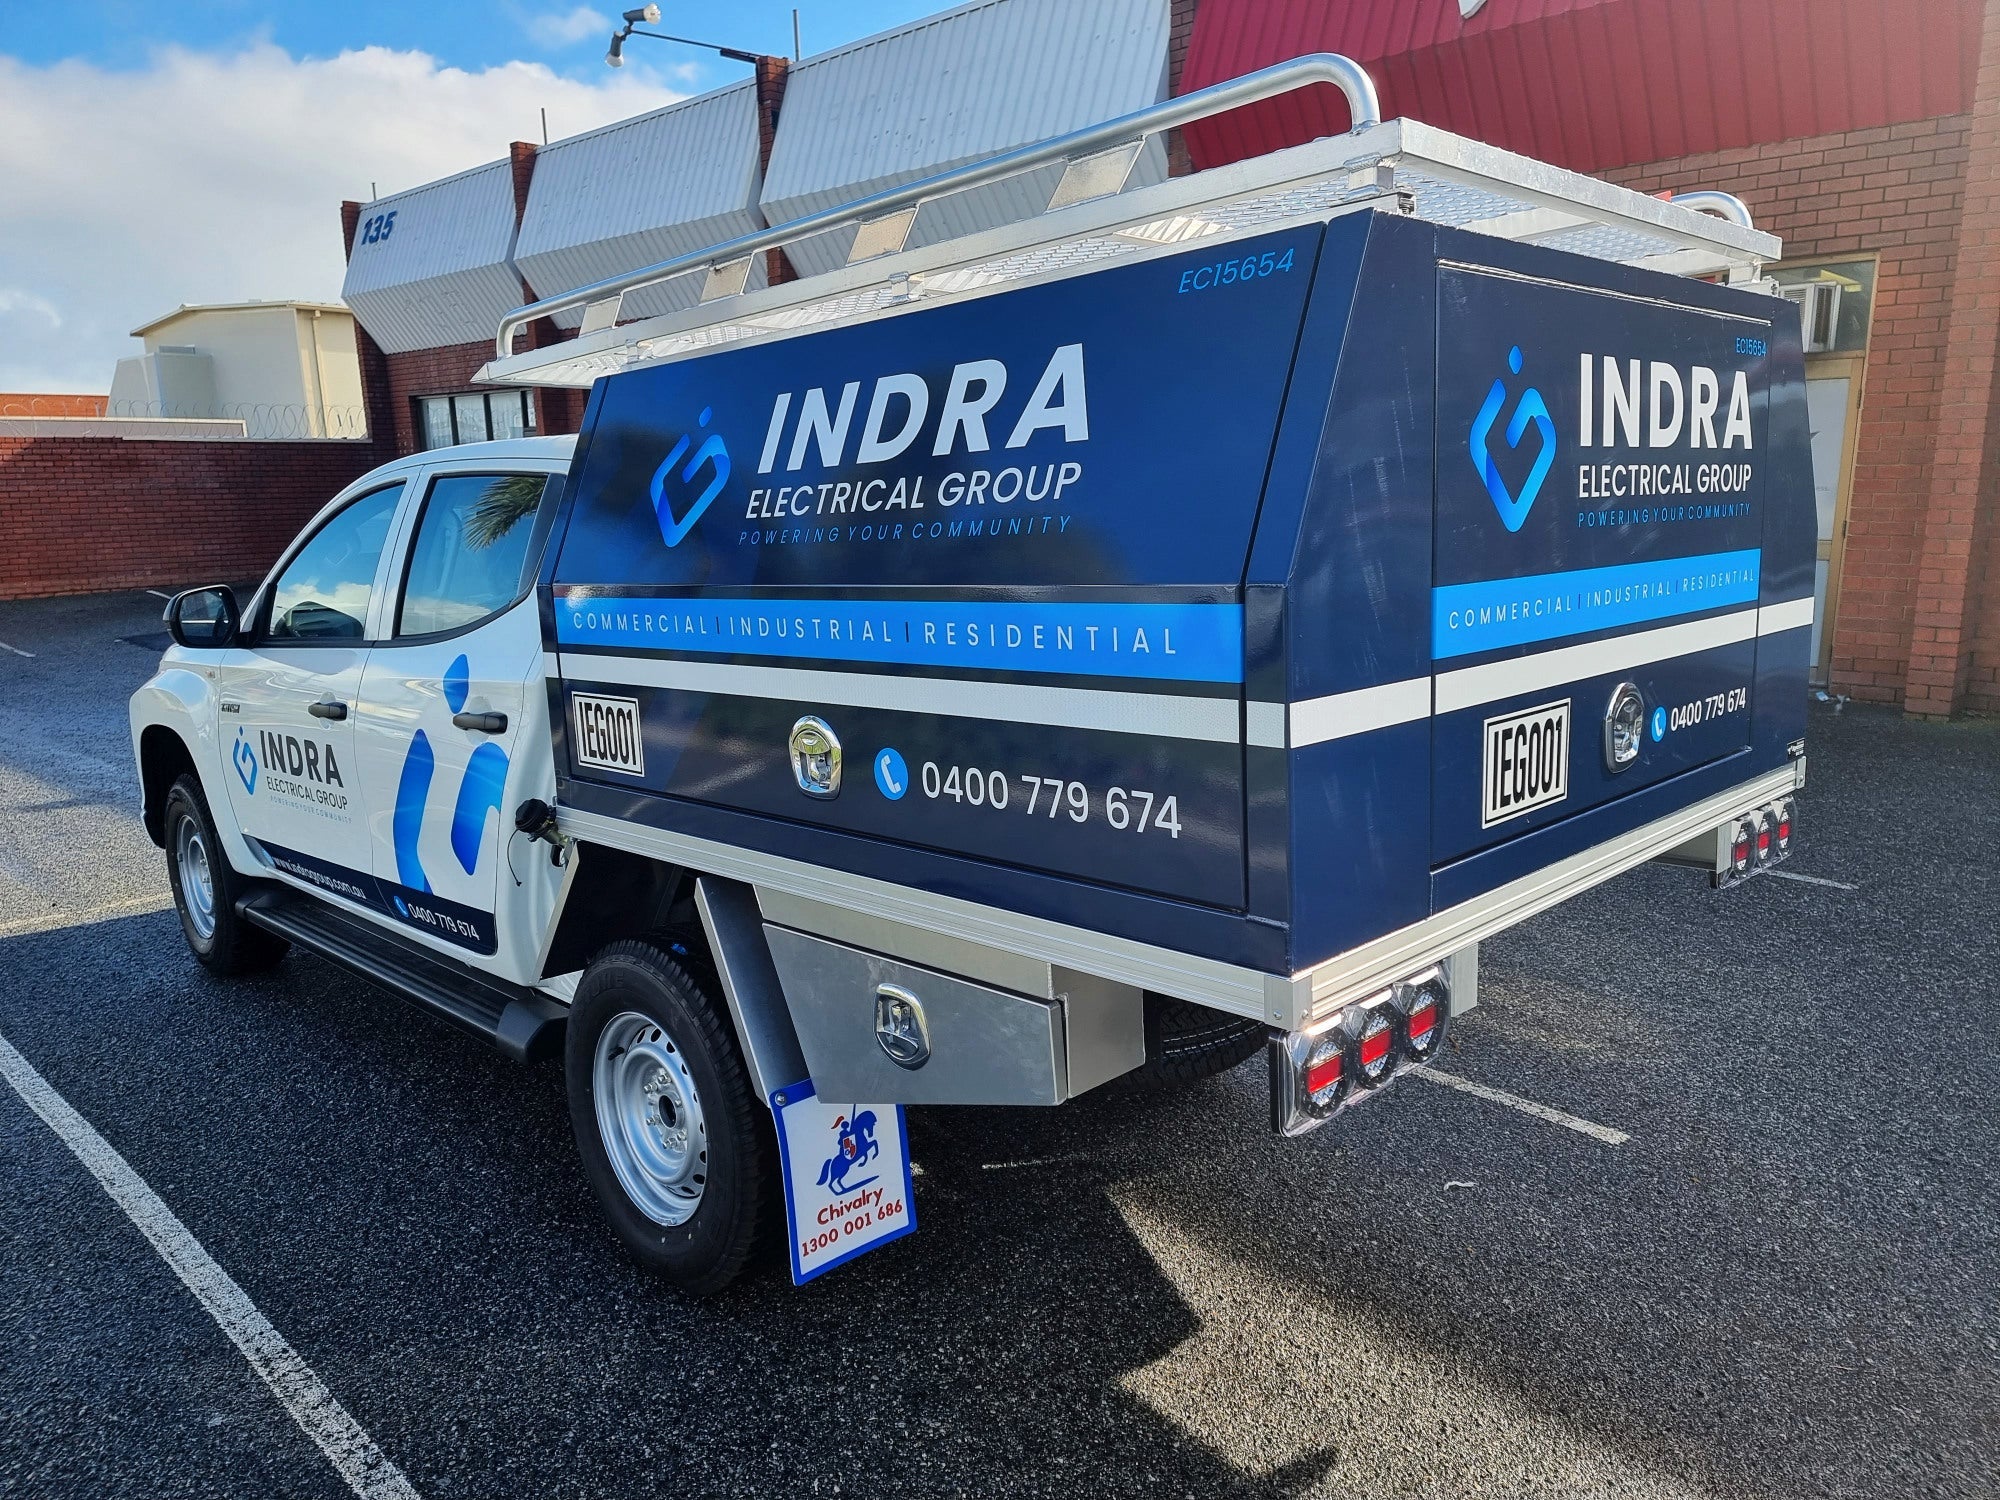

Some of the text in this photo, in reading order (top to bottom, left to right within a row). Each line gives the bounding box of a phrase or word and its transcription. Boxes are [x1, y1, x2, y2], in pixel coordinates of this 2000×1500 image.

[361, 211, 398, 245] 135
[1178, 248, 1295, 293] EC15654
[1736, 337, 1767, 357] EC15654
[757, 343, 1089, 474] INDRA
[1580, 353, 1753, 450] INDRA
[745, 462, 1082, 519] ELECTRICAL GROUP
[1579, 464, 1752, 498] ELECTRICAL GROUP
[739, 515, 1071, 545] POWERING YOUR COMMUNITY
[1578, 503, 1750, 528] POWERING YOUR COMMUNITY
[1449, 569, 1755, 630] COMMERCIAL INDUSTRIAL RESIDENTIAL
[573, 612, 1176, 655] COMMERCIAL INDUSTRIAL RESIDENTIAL
[1671, 687, 1747, 732] 0400 779 674
[578, 701, 637, 766] IEG001
[260, 730, 344, 788] INDRA
[1491, 715, 1563, 811] IEG001
[266, 776, 348, 810] ELECTRICAL GROUP
[922, 761, 1182, 839] 0400 779 674
[408, 903, 480, 940] 0400 779 674
[802, 1199, 902, 1257] 1300 001 686
[817, 1187, 884, 1225] Chivalry
